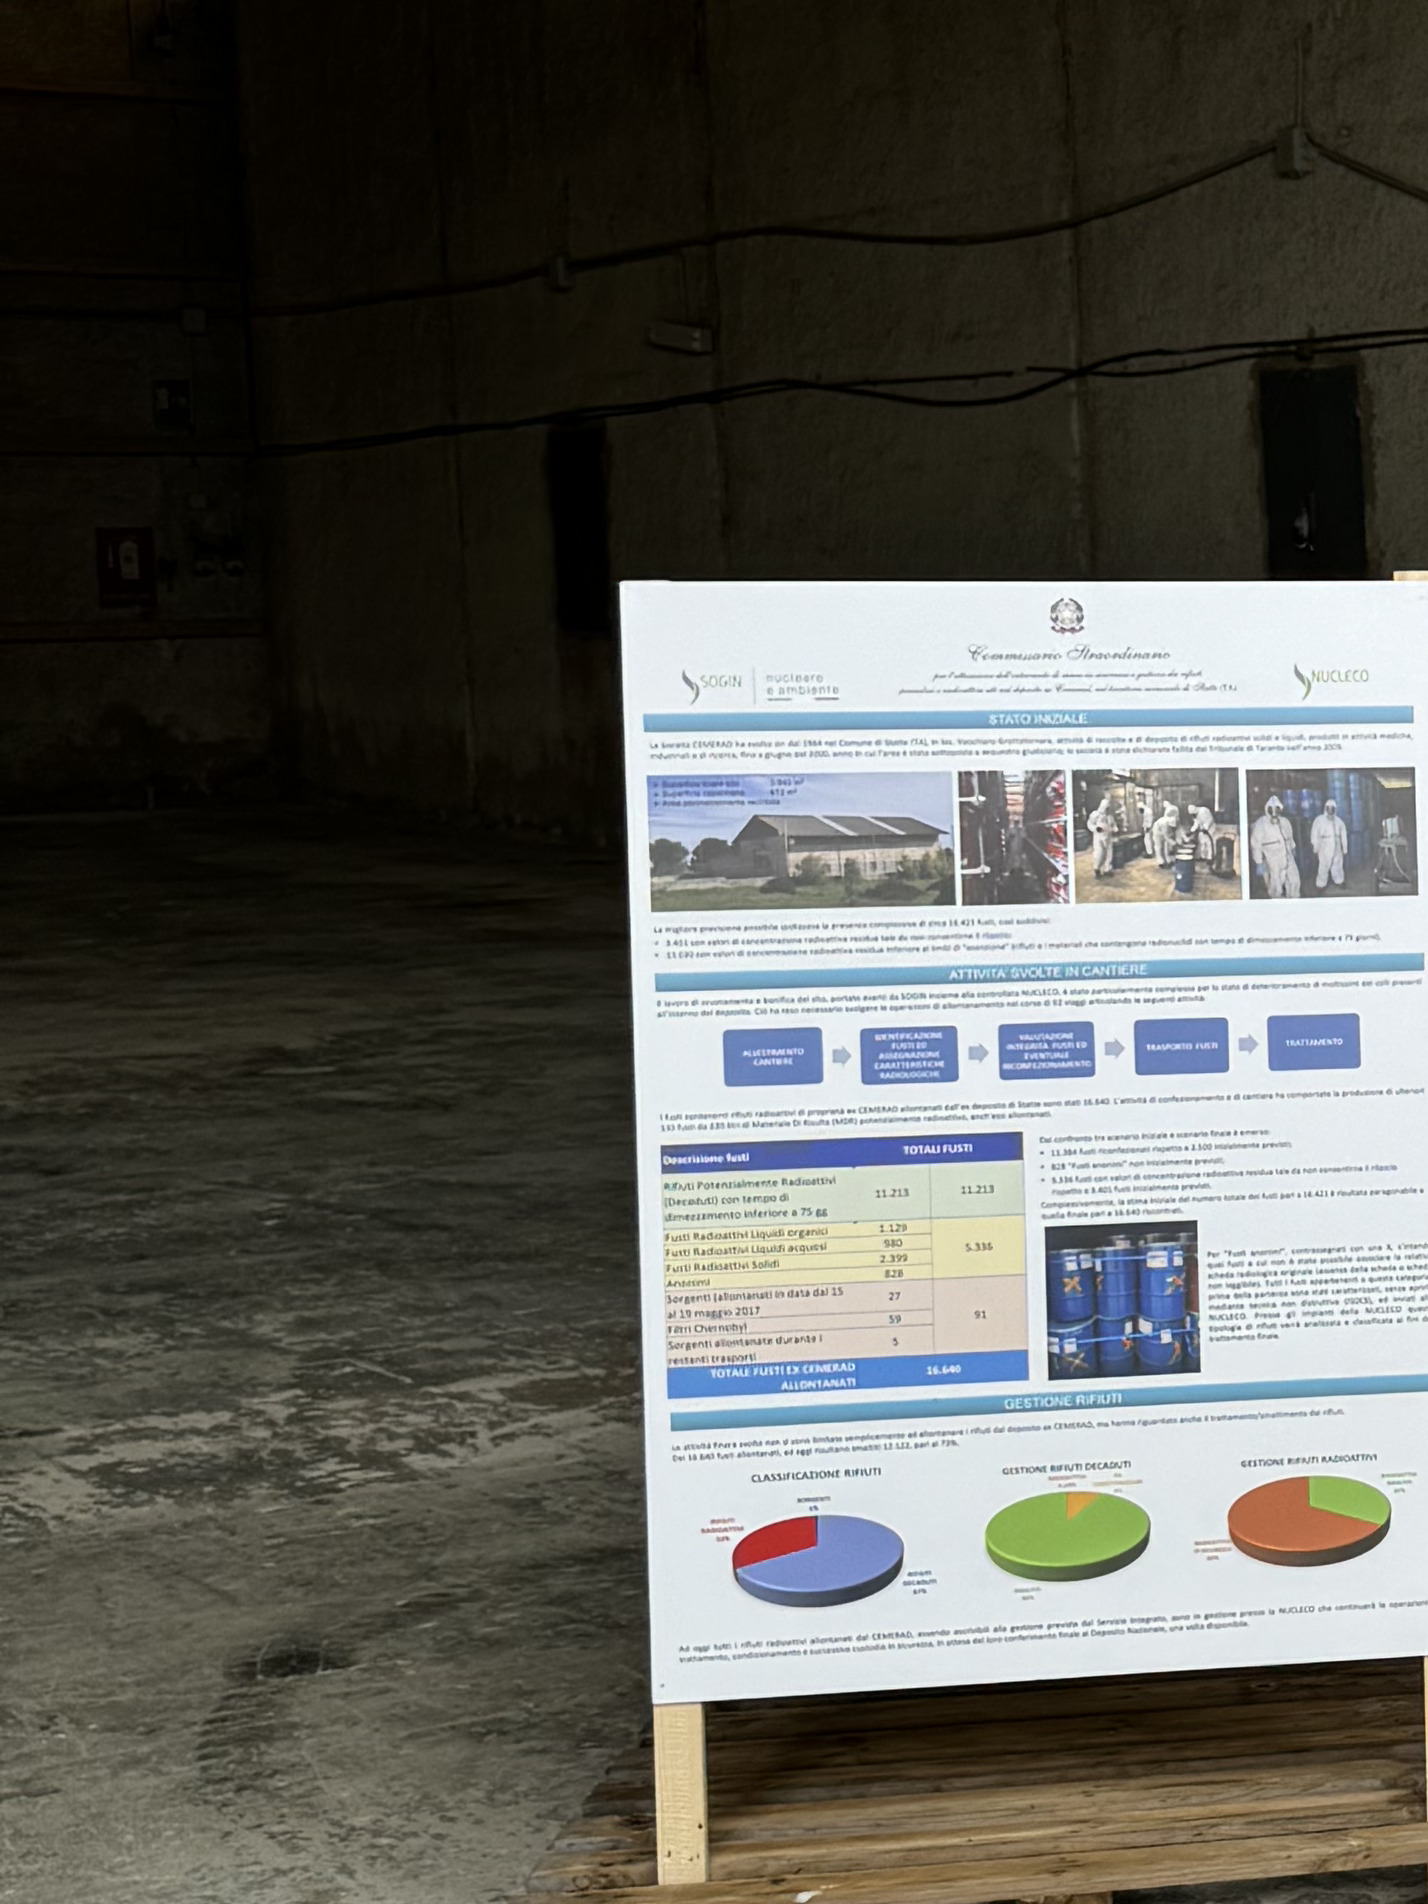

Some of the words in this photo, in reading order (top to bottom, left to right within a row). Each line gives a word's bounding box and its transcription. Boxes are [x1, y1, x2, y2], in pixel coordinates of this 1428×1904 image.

[699, 674, 742, 688] SOGIN
[1311, 669, 1369, 683] NUCLECO
[987, 712, 1032, 724] STATO
[1080, 963, 1149, 976] CANTIERE
[1285, 1037, 1343, 1046] TRATTAMENTO
[903, 1144, 941, 1155] TOTALI
[942, 1143, 973, 1153] FUSTI
[875, 1187, 909, 1198] 11.213
[961, 1184, 995, 1194] 11.213
[743, 1209, 788, 1218] inferiore
[800, 1206, 813, 1216] 75
[751, 1259, 780, 1269] Solidi
[786, 1289, 810, 1298] data
[812, 1287, 829, 1297] dal
[888, 1291, 901, 1301] 27
[734, 1305, 760, 1316] 2017
[974, 1309, 986, 1319] 91
[1003, 1394, 1072, 1409] GESTIONE
[1075, 1392, 1122, 1405] RIFIUTI
[1240, 1457, 1284, 1468] GESTIONE
[1286, 1455, 1319, 1465] RIFIUTI
[1320, 1452, 1378, 1463] RADIOATTIVI
[1001, 1465, 1047, 1475] GESTIONE
[1049, 1462, 1083, 1472] RIFIUTI
[1084, 1460, 1131, 1471] DECADUTI
[750, 1469, 840, 1483] CLASSIFICAZIONE
[843, 1467, 881, 1477] RIFIUTI
